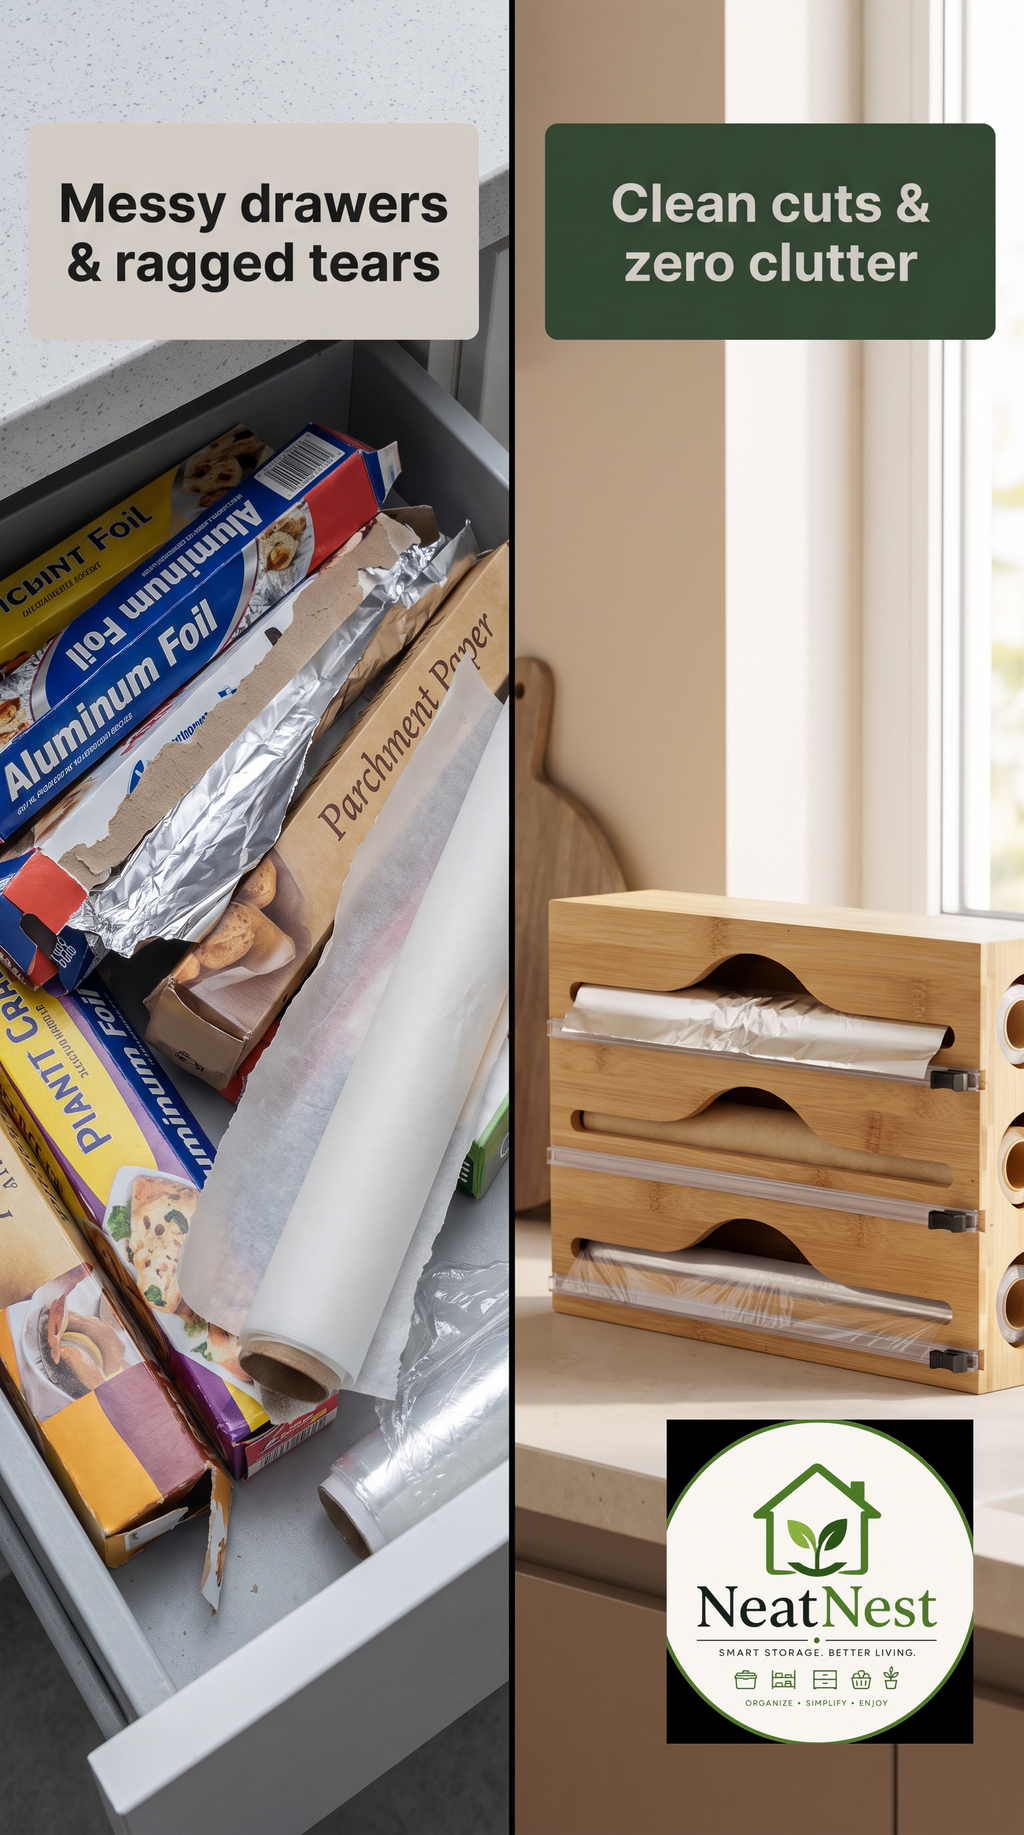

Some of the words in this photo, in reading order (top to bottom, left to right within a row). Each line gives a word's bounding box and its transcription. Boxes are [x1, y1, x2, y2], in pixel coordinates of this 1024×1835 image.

[118, 499, 263, 620] Aluminum
[4, 656, 160, 803] Aluminum
[157, 598, 218, 668] Foil
[65, 616, 128, 672] Foil
[317, 686, 439, 842] Parchment
[76, 988, 127, 1037] Foil
